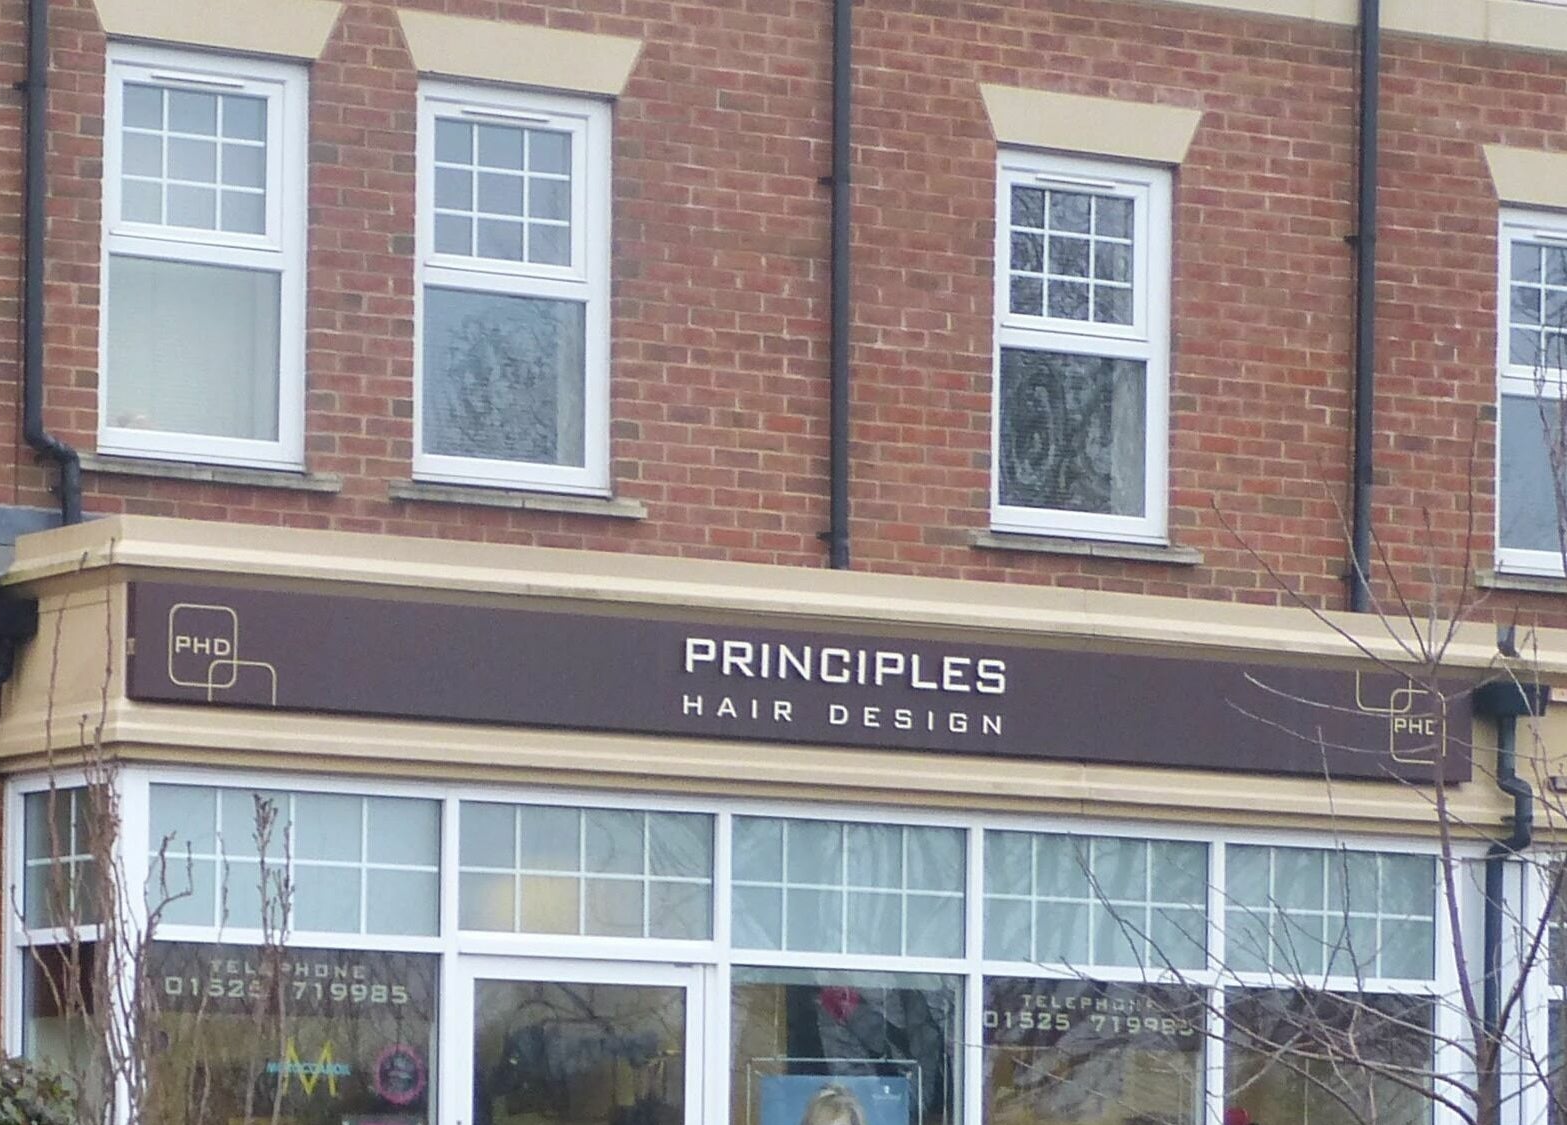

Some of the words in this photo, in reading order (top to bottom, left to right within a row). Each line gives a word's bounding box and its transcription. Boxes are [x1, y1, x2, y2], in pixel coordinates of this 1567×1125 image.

[175, 635, 232, 656] PHD
[685, 637, 1007, 695] PRINCIPLES
[682, 694, 793, 723] HAIR
[829, 704, 1003, 736] DESIGN
[211, 959, 366, 980] TELPHONE
[293, 981, 409, 1004] 719985
[983, 1010, 1072, 1031] 01525
